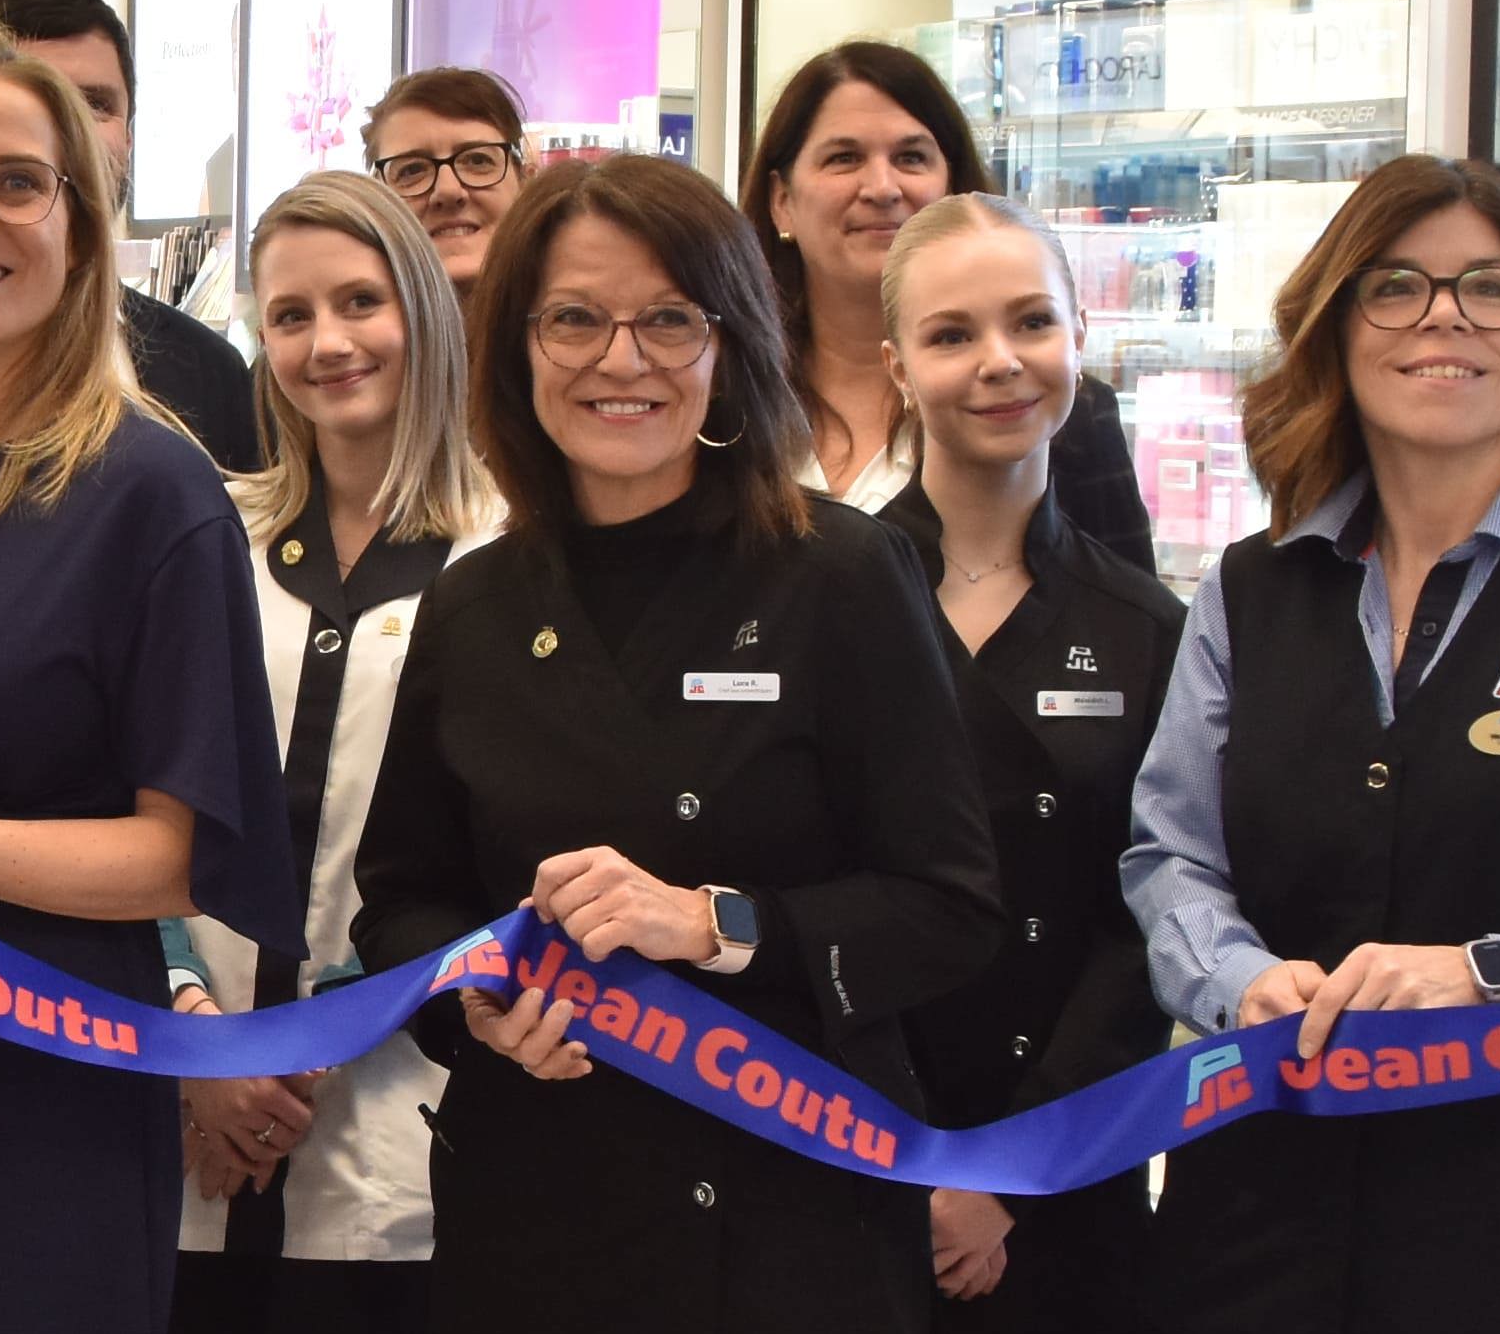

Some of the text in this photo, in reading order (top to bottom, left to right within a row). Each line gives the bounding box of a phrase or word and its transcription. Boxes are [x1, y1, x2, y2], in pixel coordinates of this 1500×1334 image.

[517, 940, 899, 1172] Jean Coutu
[1279, 1039, 1472, 1096] Jean
